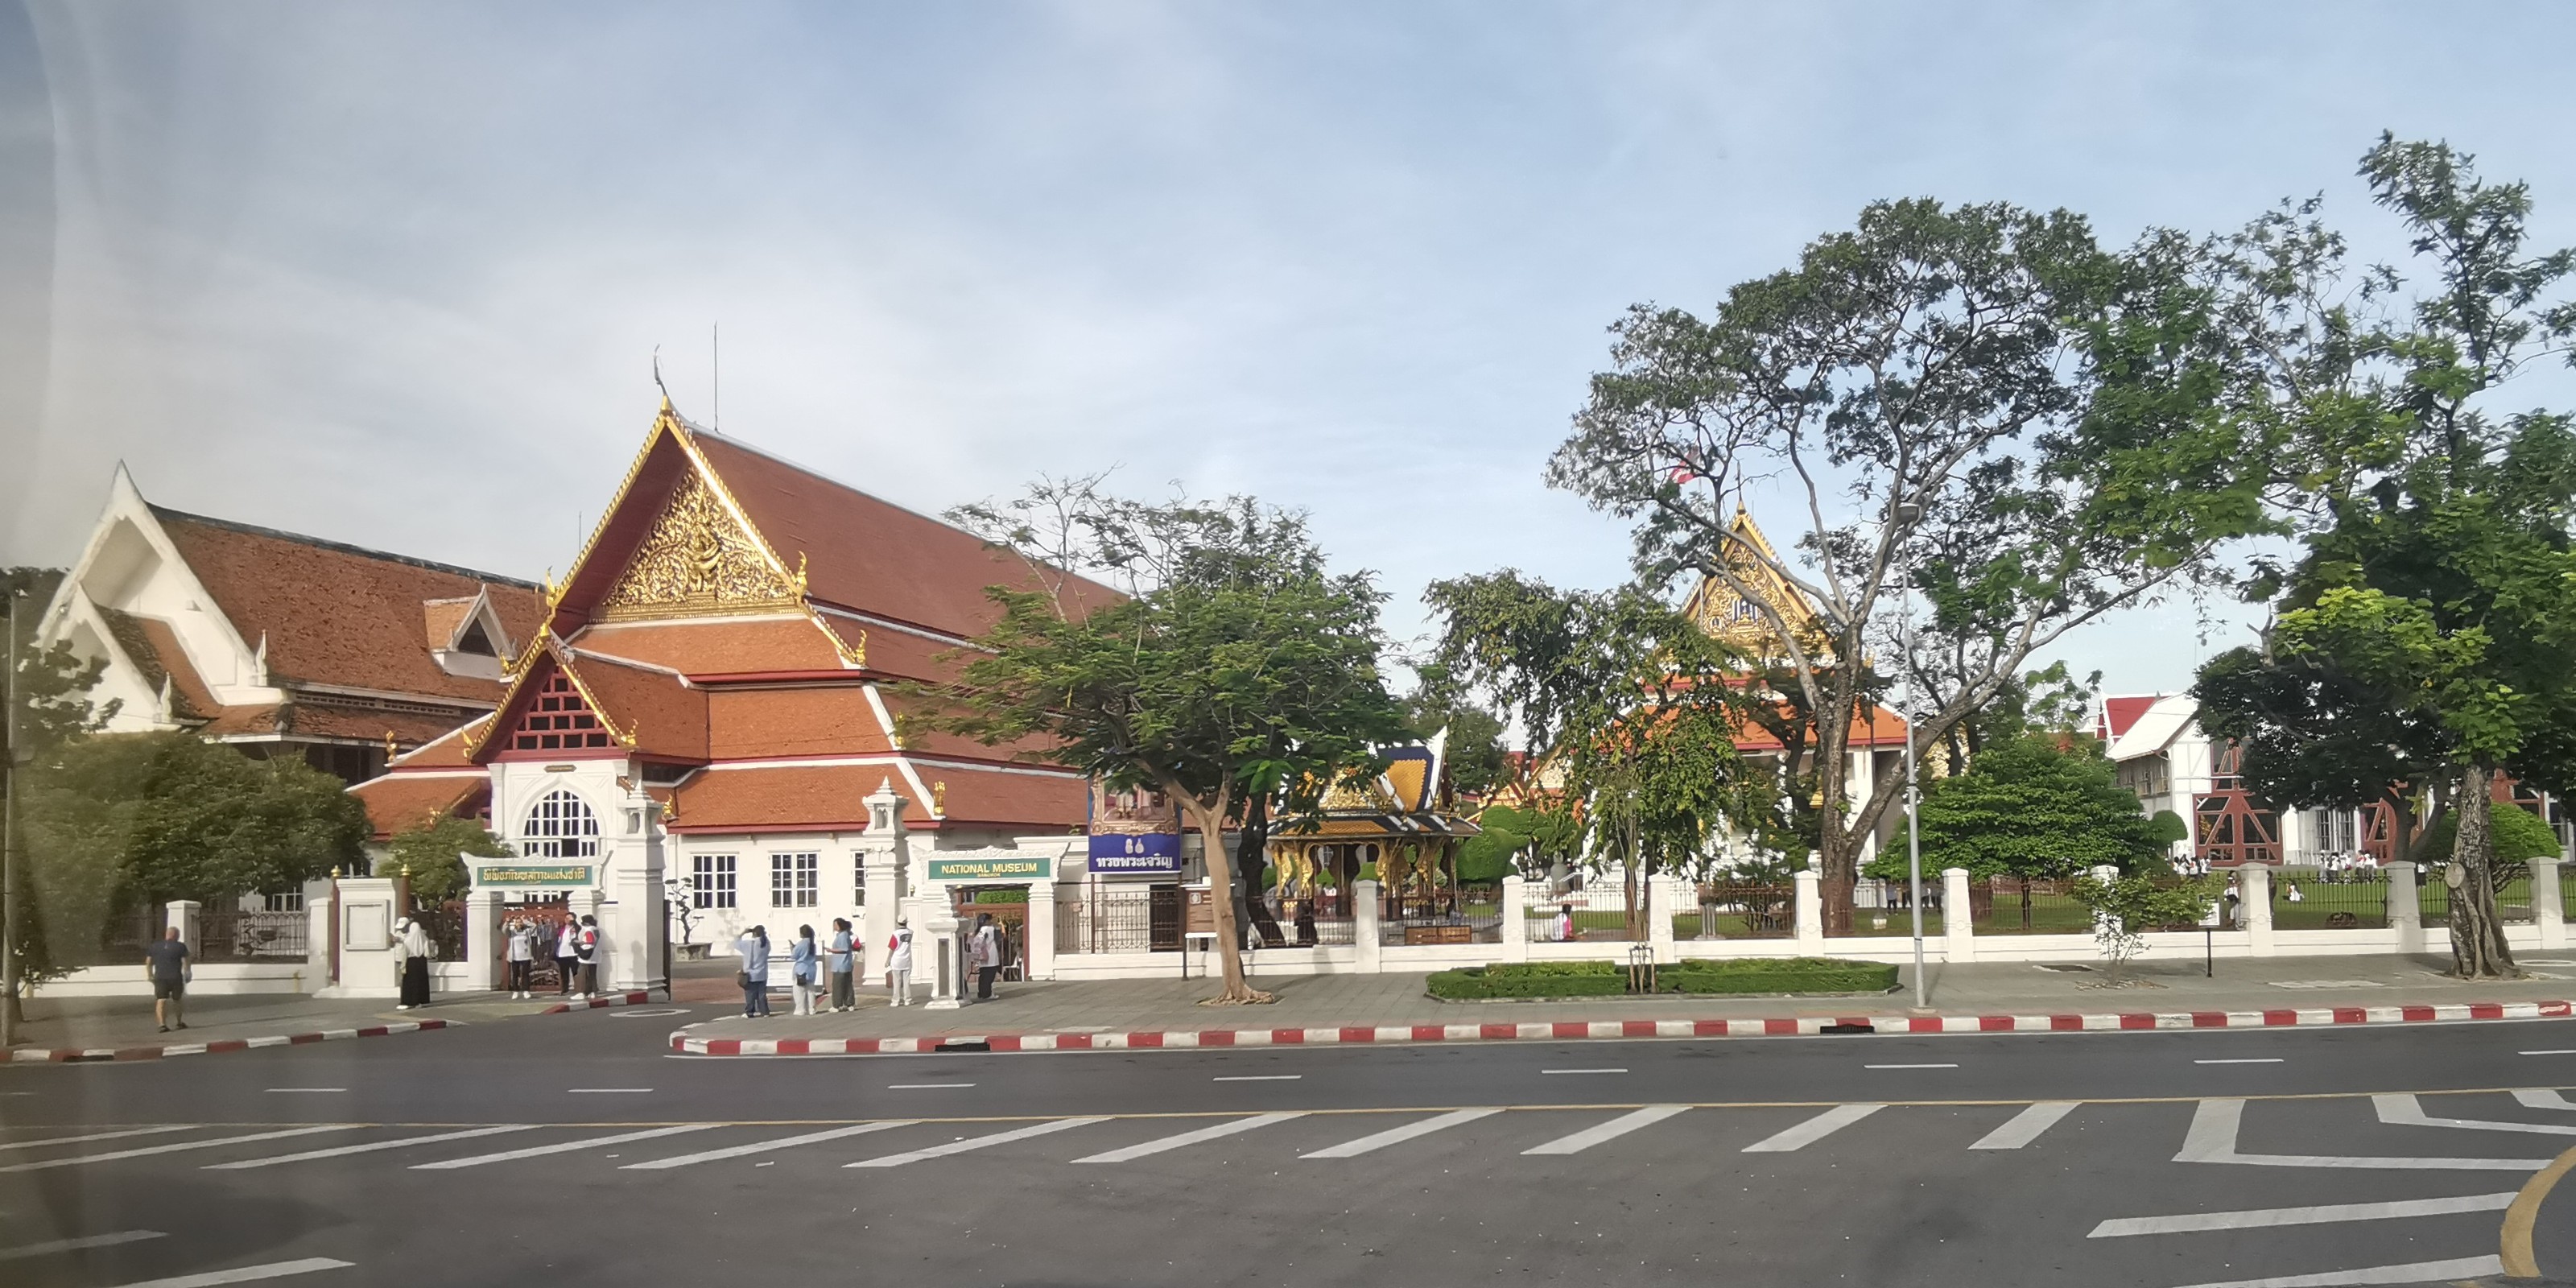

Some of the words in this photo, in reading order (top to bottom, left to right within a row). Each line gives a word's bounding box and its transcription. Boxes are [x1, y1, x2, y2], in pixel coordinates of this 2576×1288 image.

[1096, 853, 1173, 869] ทรงพระเจริญ
[941, 865, 989, 873] NATIONAL
[993, 863, 1037, 873] MUSEUM
